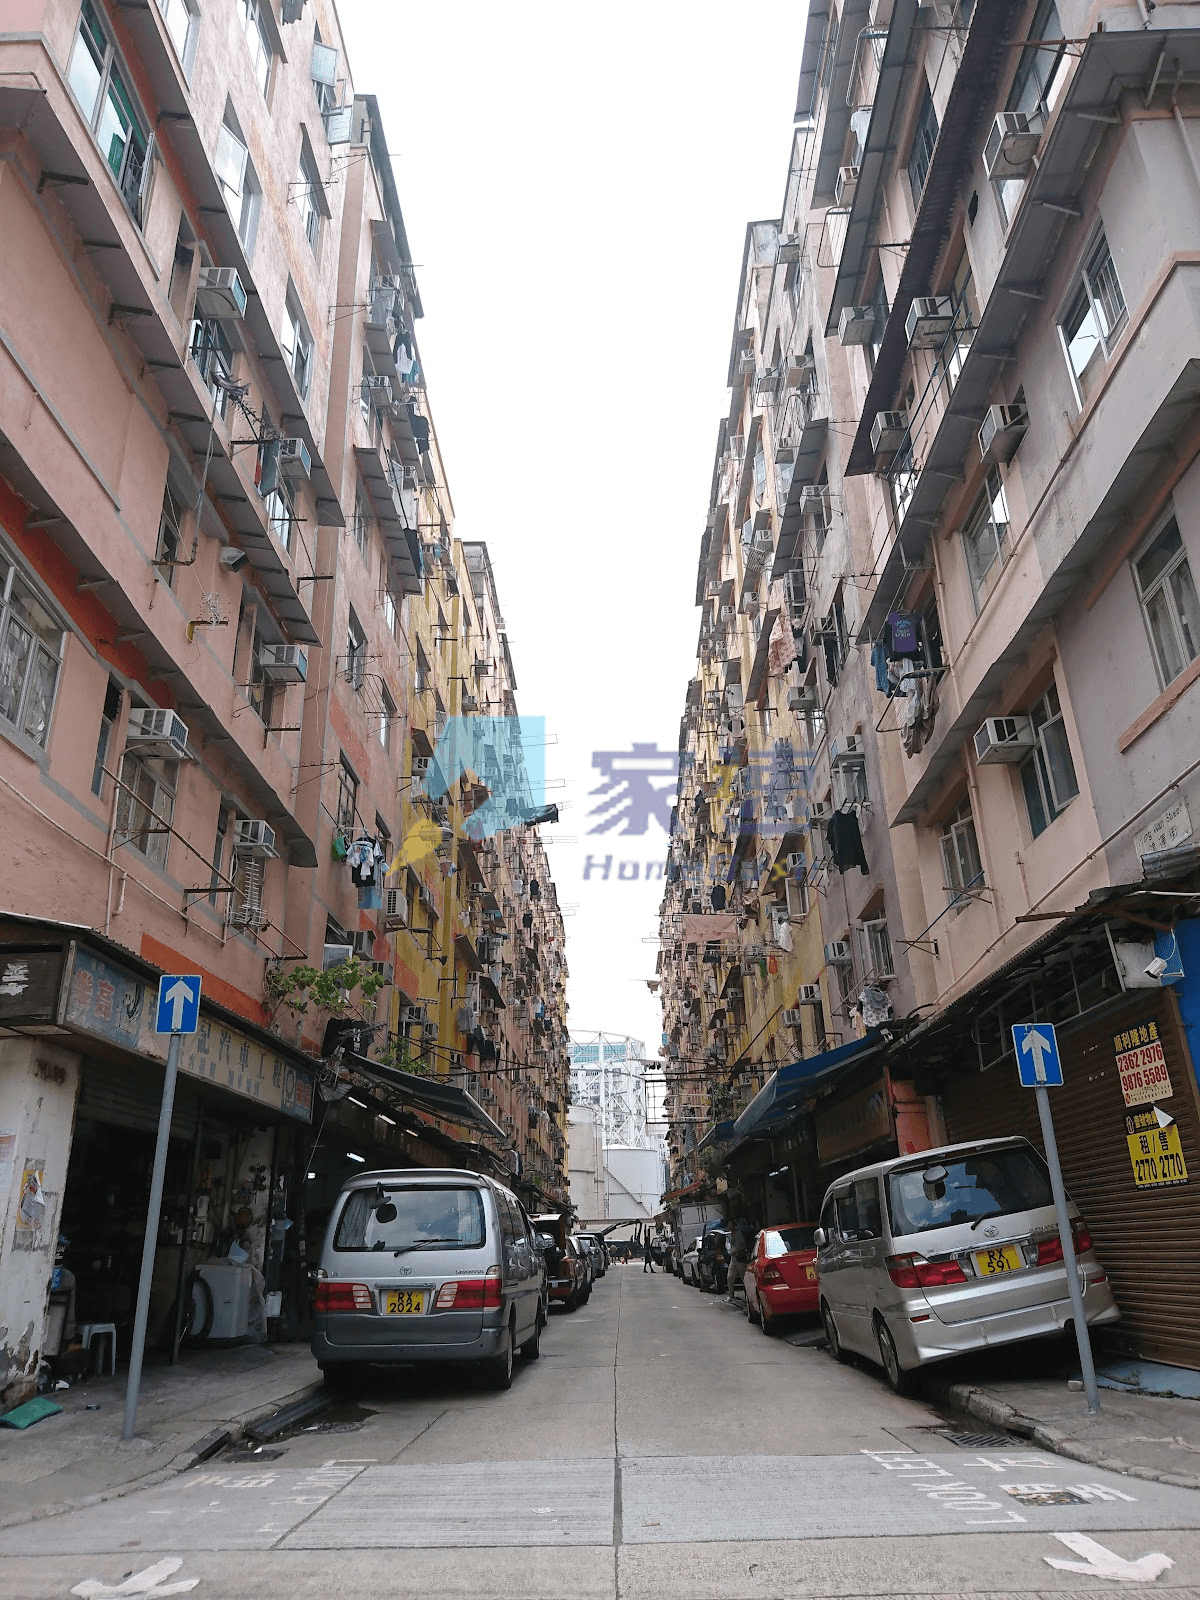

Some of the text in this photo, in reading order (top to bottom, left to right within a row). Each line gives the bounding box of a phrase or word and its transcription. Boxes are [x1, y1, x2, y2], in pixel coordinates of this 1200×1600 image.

[1113, 1022, 1159, 1052] 順利隆地產
[1117, 1044, 1163, 1072] 2362 2976
[1122, 1064, 1168, 1091] 9876 5589
[1135, 1153, 1184, 1181] 2770 2770
[988, 1248, 1006, 1262] RX
[988, 1259, 1011, 1273] 591
[389, 1303, 421, 1313] 2024
[397, 1292, 413, 1302] RX
[860, 1449, 1028, 1525] LOOK LEFT
